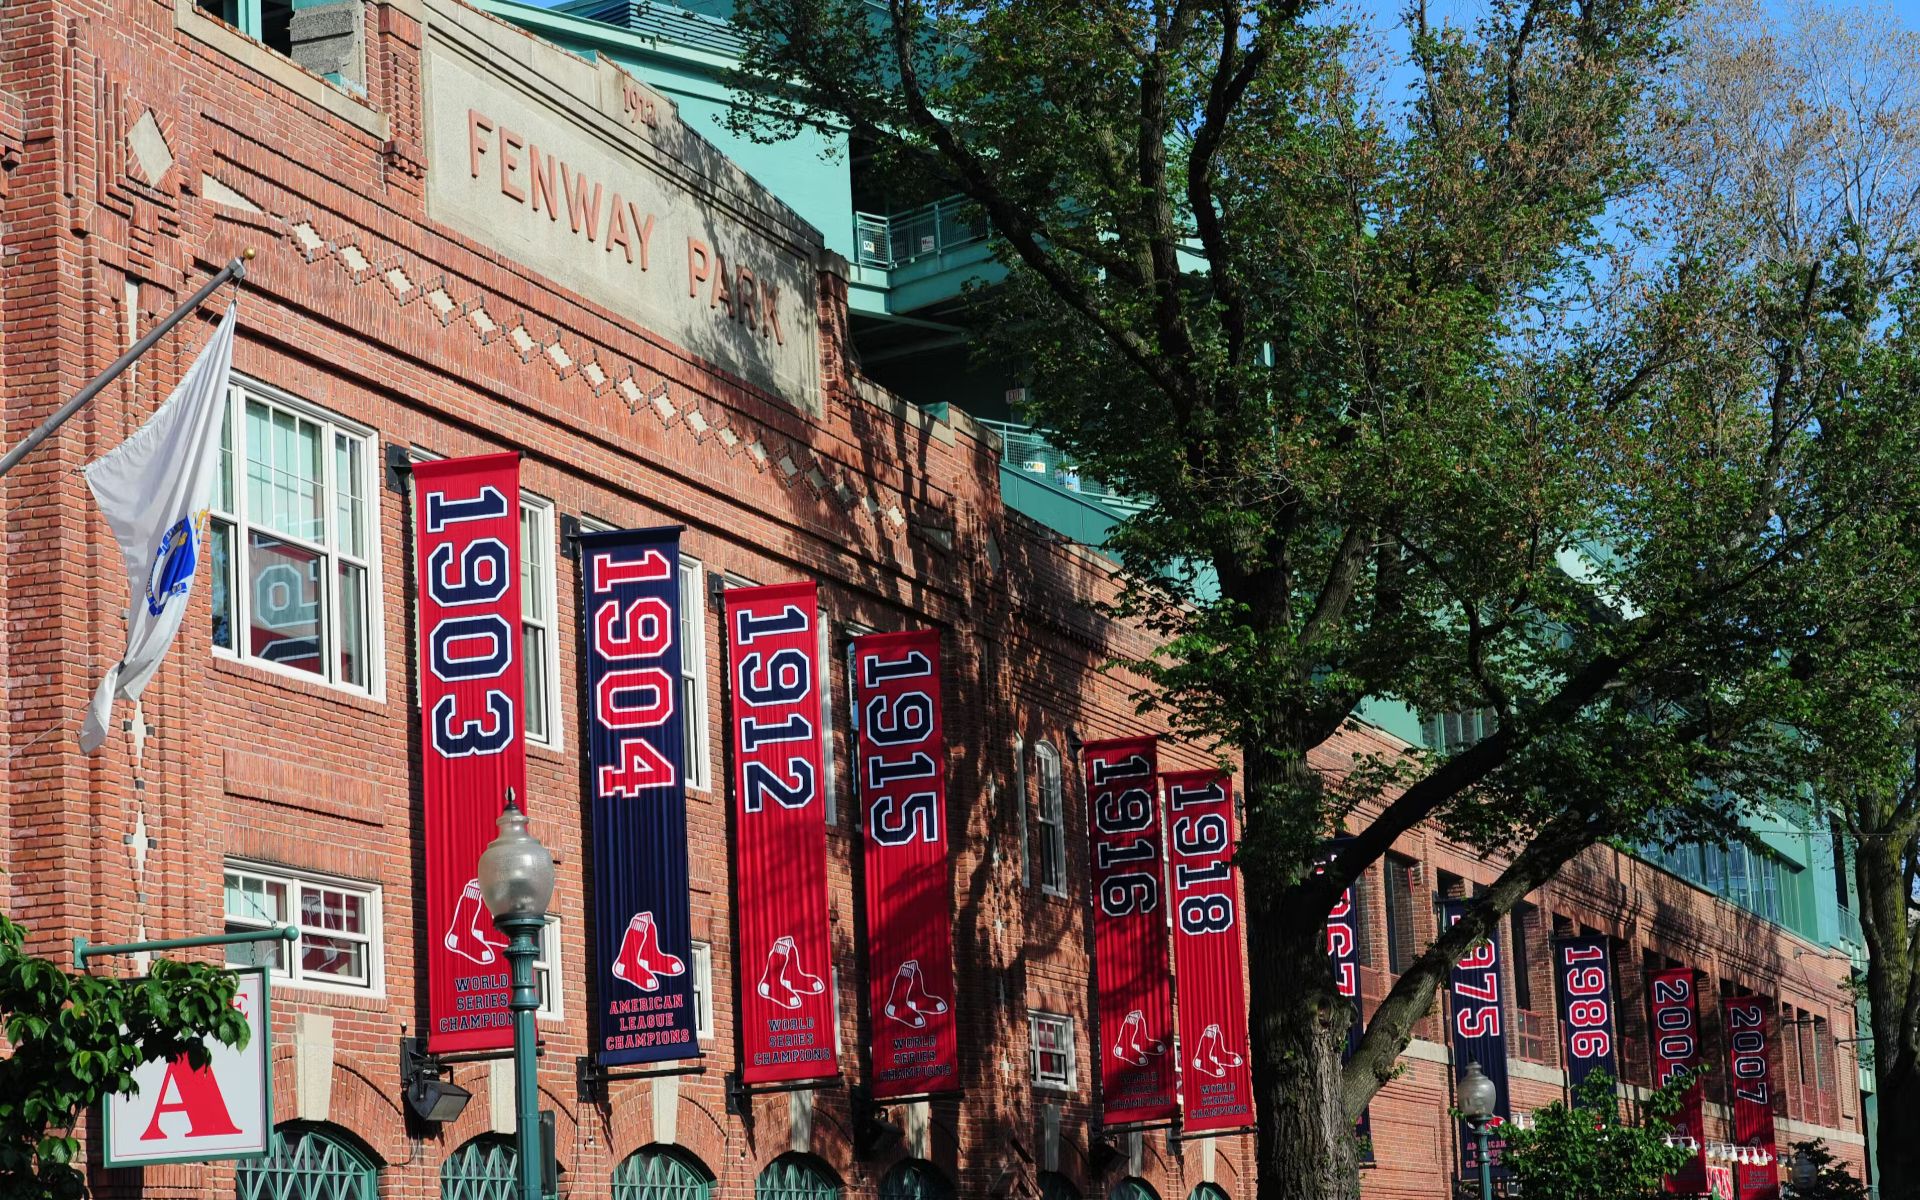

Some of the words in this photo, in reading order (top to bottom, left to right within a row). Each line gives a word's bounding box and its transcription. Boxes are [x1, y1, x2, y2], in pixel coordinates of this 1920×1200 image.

[623, 86, 656, 129] 1912
[468, 109, 655, 272] FENWAY
[686, 236, 784, 345] PARK
[426, 486, 514, 759] 1903
[594, 550, 675, 798] 1904
[736, 604, 815, 813] 1912
[864, 651, 938, 846] 1915
[1093, 755, 1157, 917] 1916
[1171, 783, 1233, 936] 1918
[455, 973, 509, 992] WORLD
[457, 993, 509, 1011] SERIES
[609, 994, 684, 1015] AMERICAN
[1451, 915, 1500, 1038] 975
[1565, 946, 1609, 1059] 1986
[440, 1011, 515, 1032] CHAMPION
[606, 1028, 690, 1050] CHAMPIONS
[620, 1012, 674, 1031] LEAGUE
[768, 1017, 815, 1032] WORLD
[769, 1033, 814, 1048] SERIES
[893, 1036, 937, 1050] WORLD
[1731, 1005, 1768, 1104] 2007
[754, 1048, 830, 1066] CHAMPIONS
[139, 1050, 243, 1141] A
